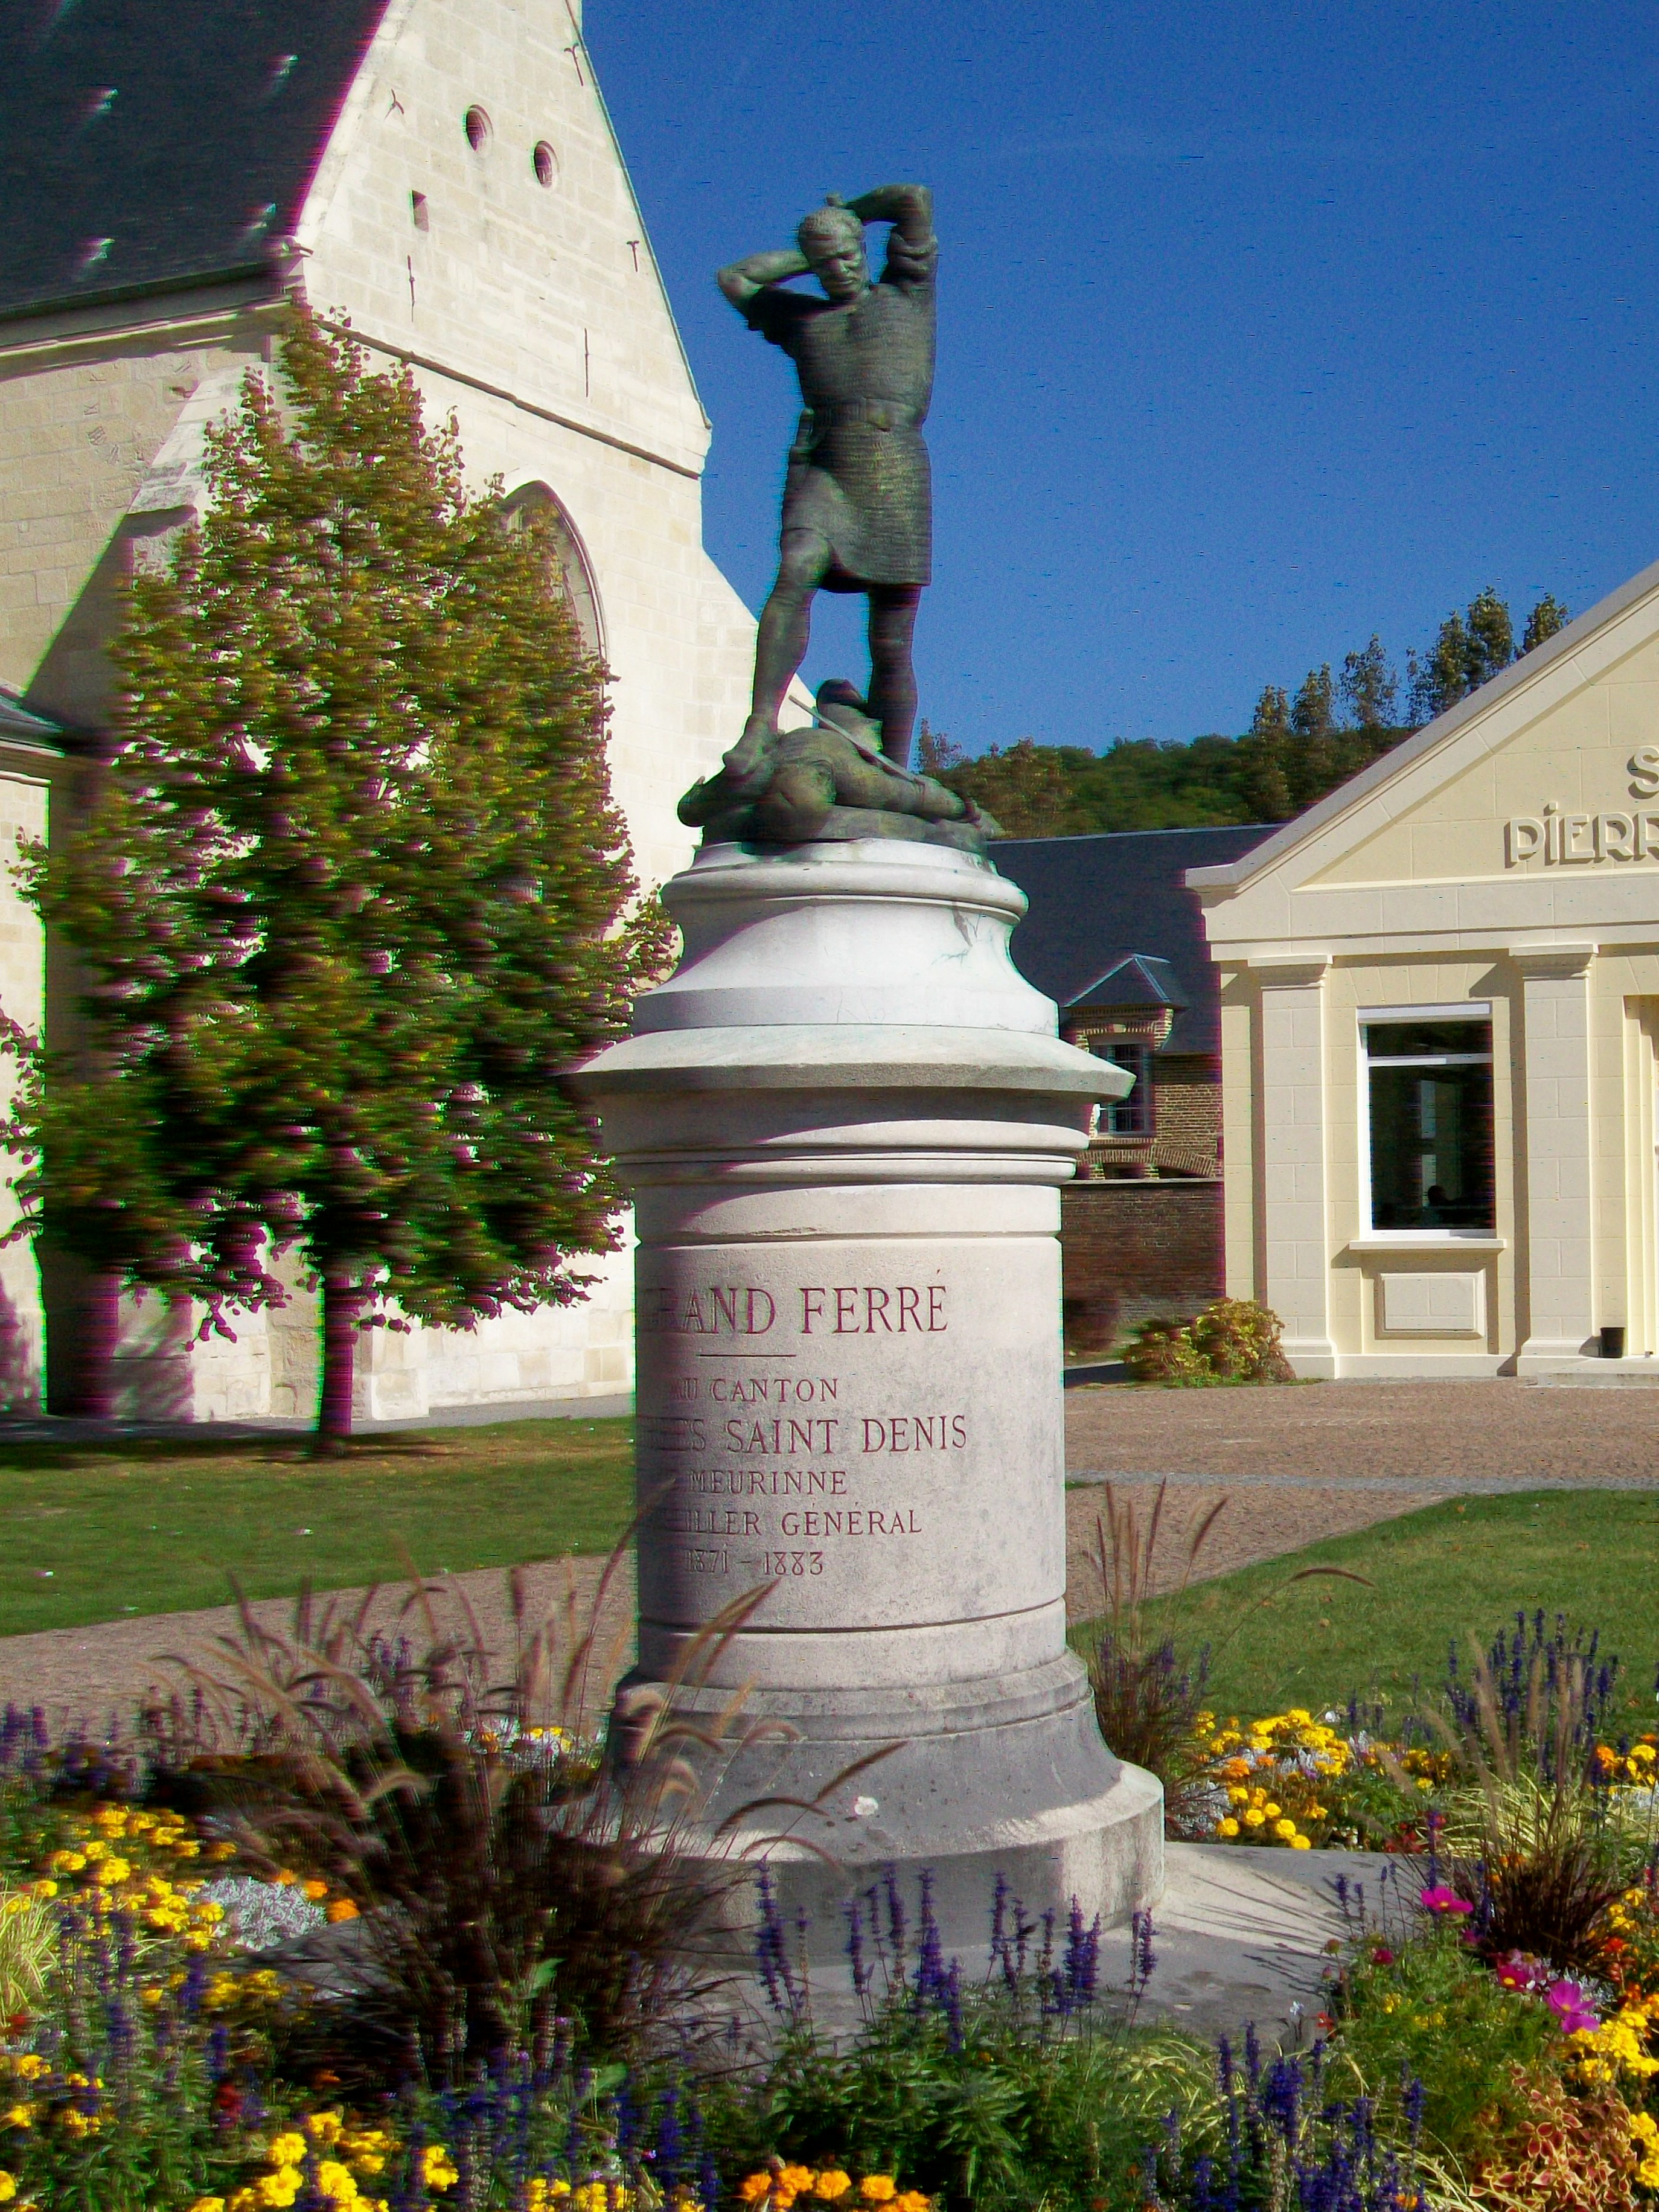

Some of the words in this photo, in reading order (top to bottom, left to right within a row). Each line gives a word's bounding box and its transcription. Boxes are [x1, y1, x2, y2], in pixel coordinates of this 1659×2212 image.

[799, 1269, 948, 1334] FERRÉ
[709, 1378, 839, 1403] CANTON
[726, 1419, 839, 1454] SAINT
[861, 1416, 967, 1453] DENIS
[688, 1471, 848, 1495] MEURINNE
[781, 1502, 922, 1536] GÉNÉRAL
[764, 1551, 823, 1576] 1883
